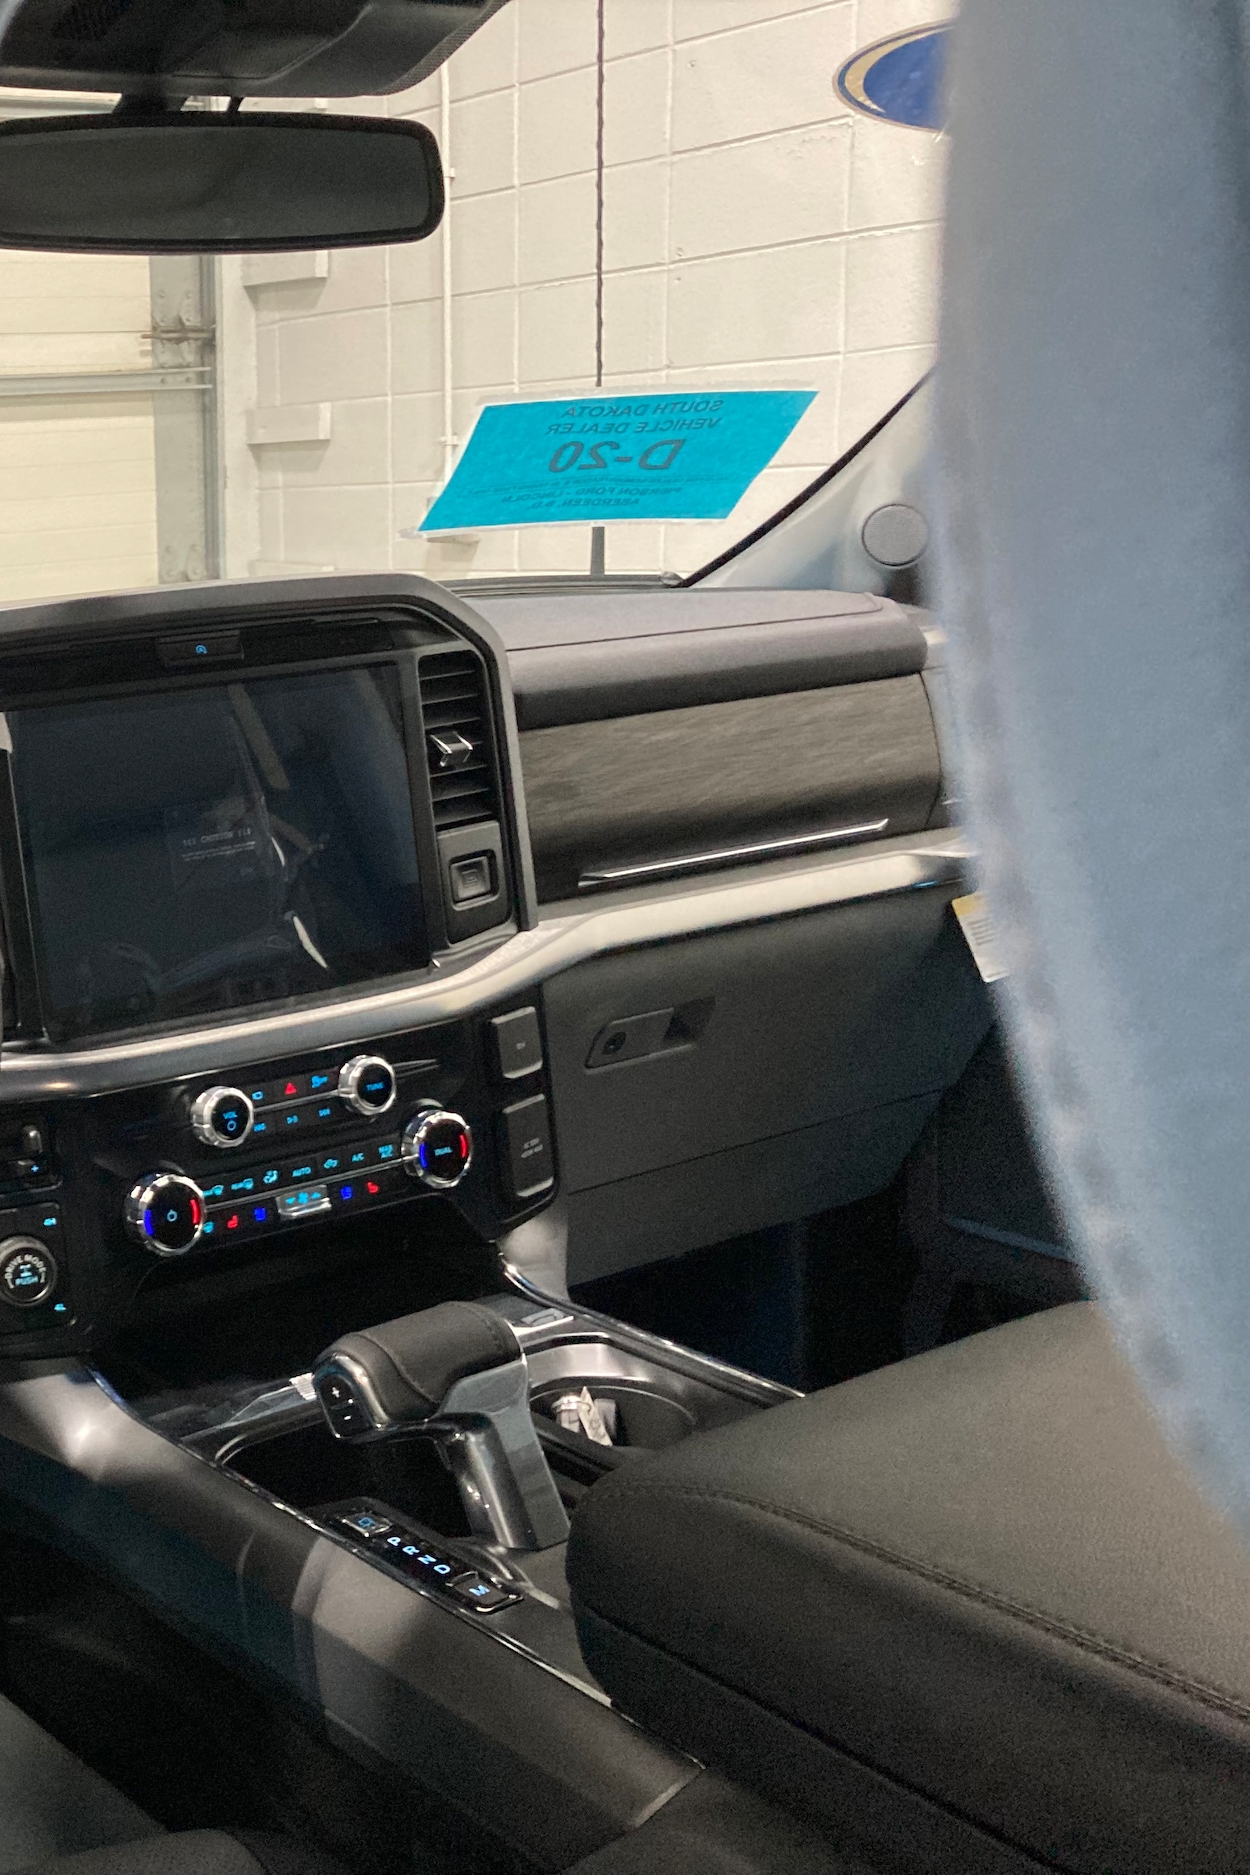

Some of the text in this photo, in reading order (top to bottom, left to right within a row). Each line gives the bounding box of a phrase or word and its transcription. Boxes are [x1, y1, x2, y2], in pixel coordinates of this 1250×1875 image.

[366, 1081, 384, 1092] TUNE
[222, 1110, 238, 1120] VOL
[434, 1146, 453, 1156] DUAL
[352, 1152, 364, 1163] A/C
[292, 1165, 312, 1178] AUTO
[4, 1253, 47, 1279] DRIVE MODE
[387, 1536, 451, 1574] P R N D
[468, 1584, 490, 1597] M
